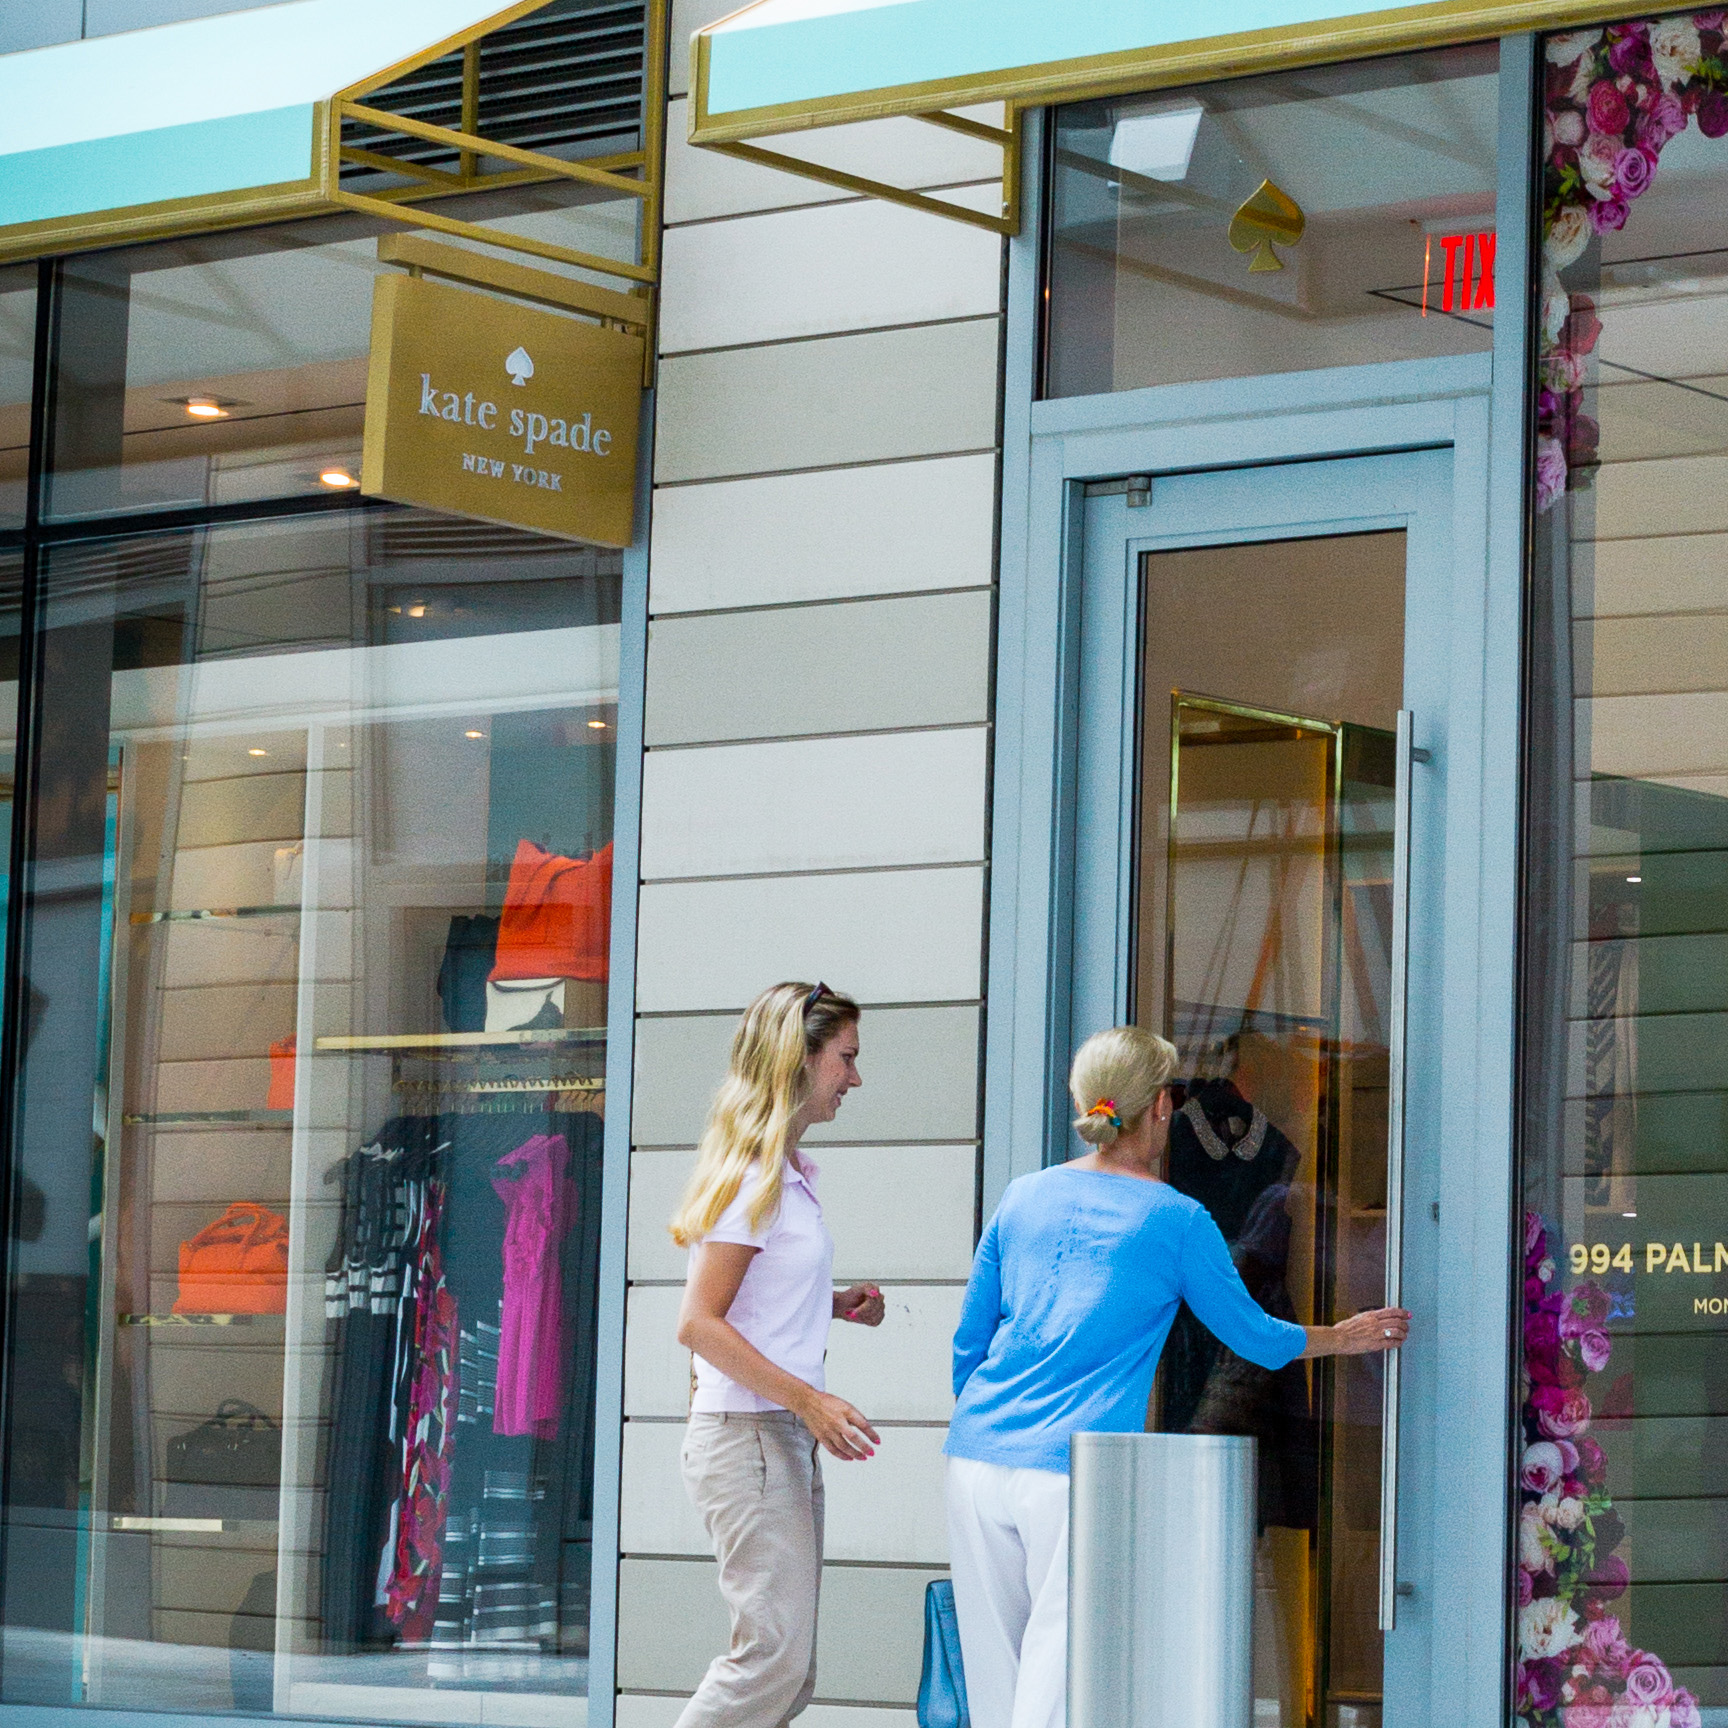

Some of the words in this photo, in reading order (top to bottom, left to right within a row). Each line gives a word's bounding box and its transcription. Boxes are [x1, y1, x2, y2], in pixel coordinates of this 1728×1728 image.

[418, 373, 498, 430] kate
[509, 409, 612, 456] spade
[461, 453, 505, 478] NEW
[511, 463, 563, 492] YORK
[1569, 1243, 1633, 1273] 994
